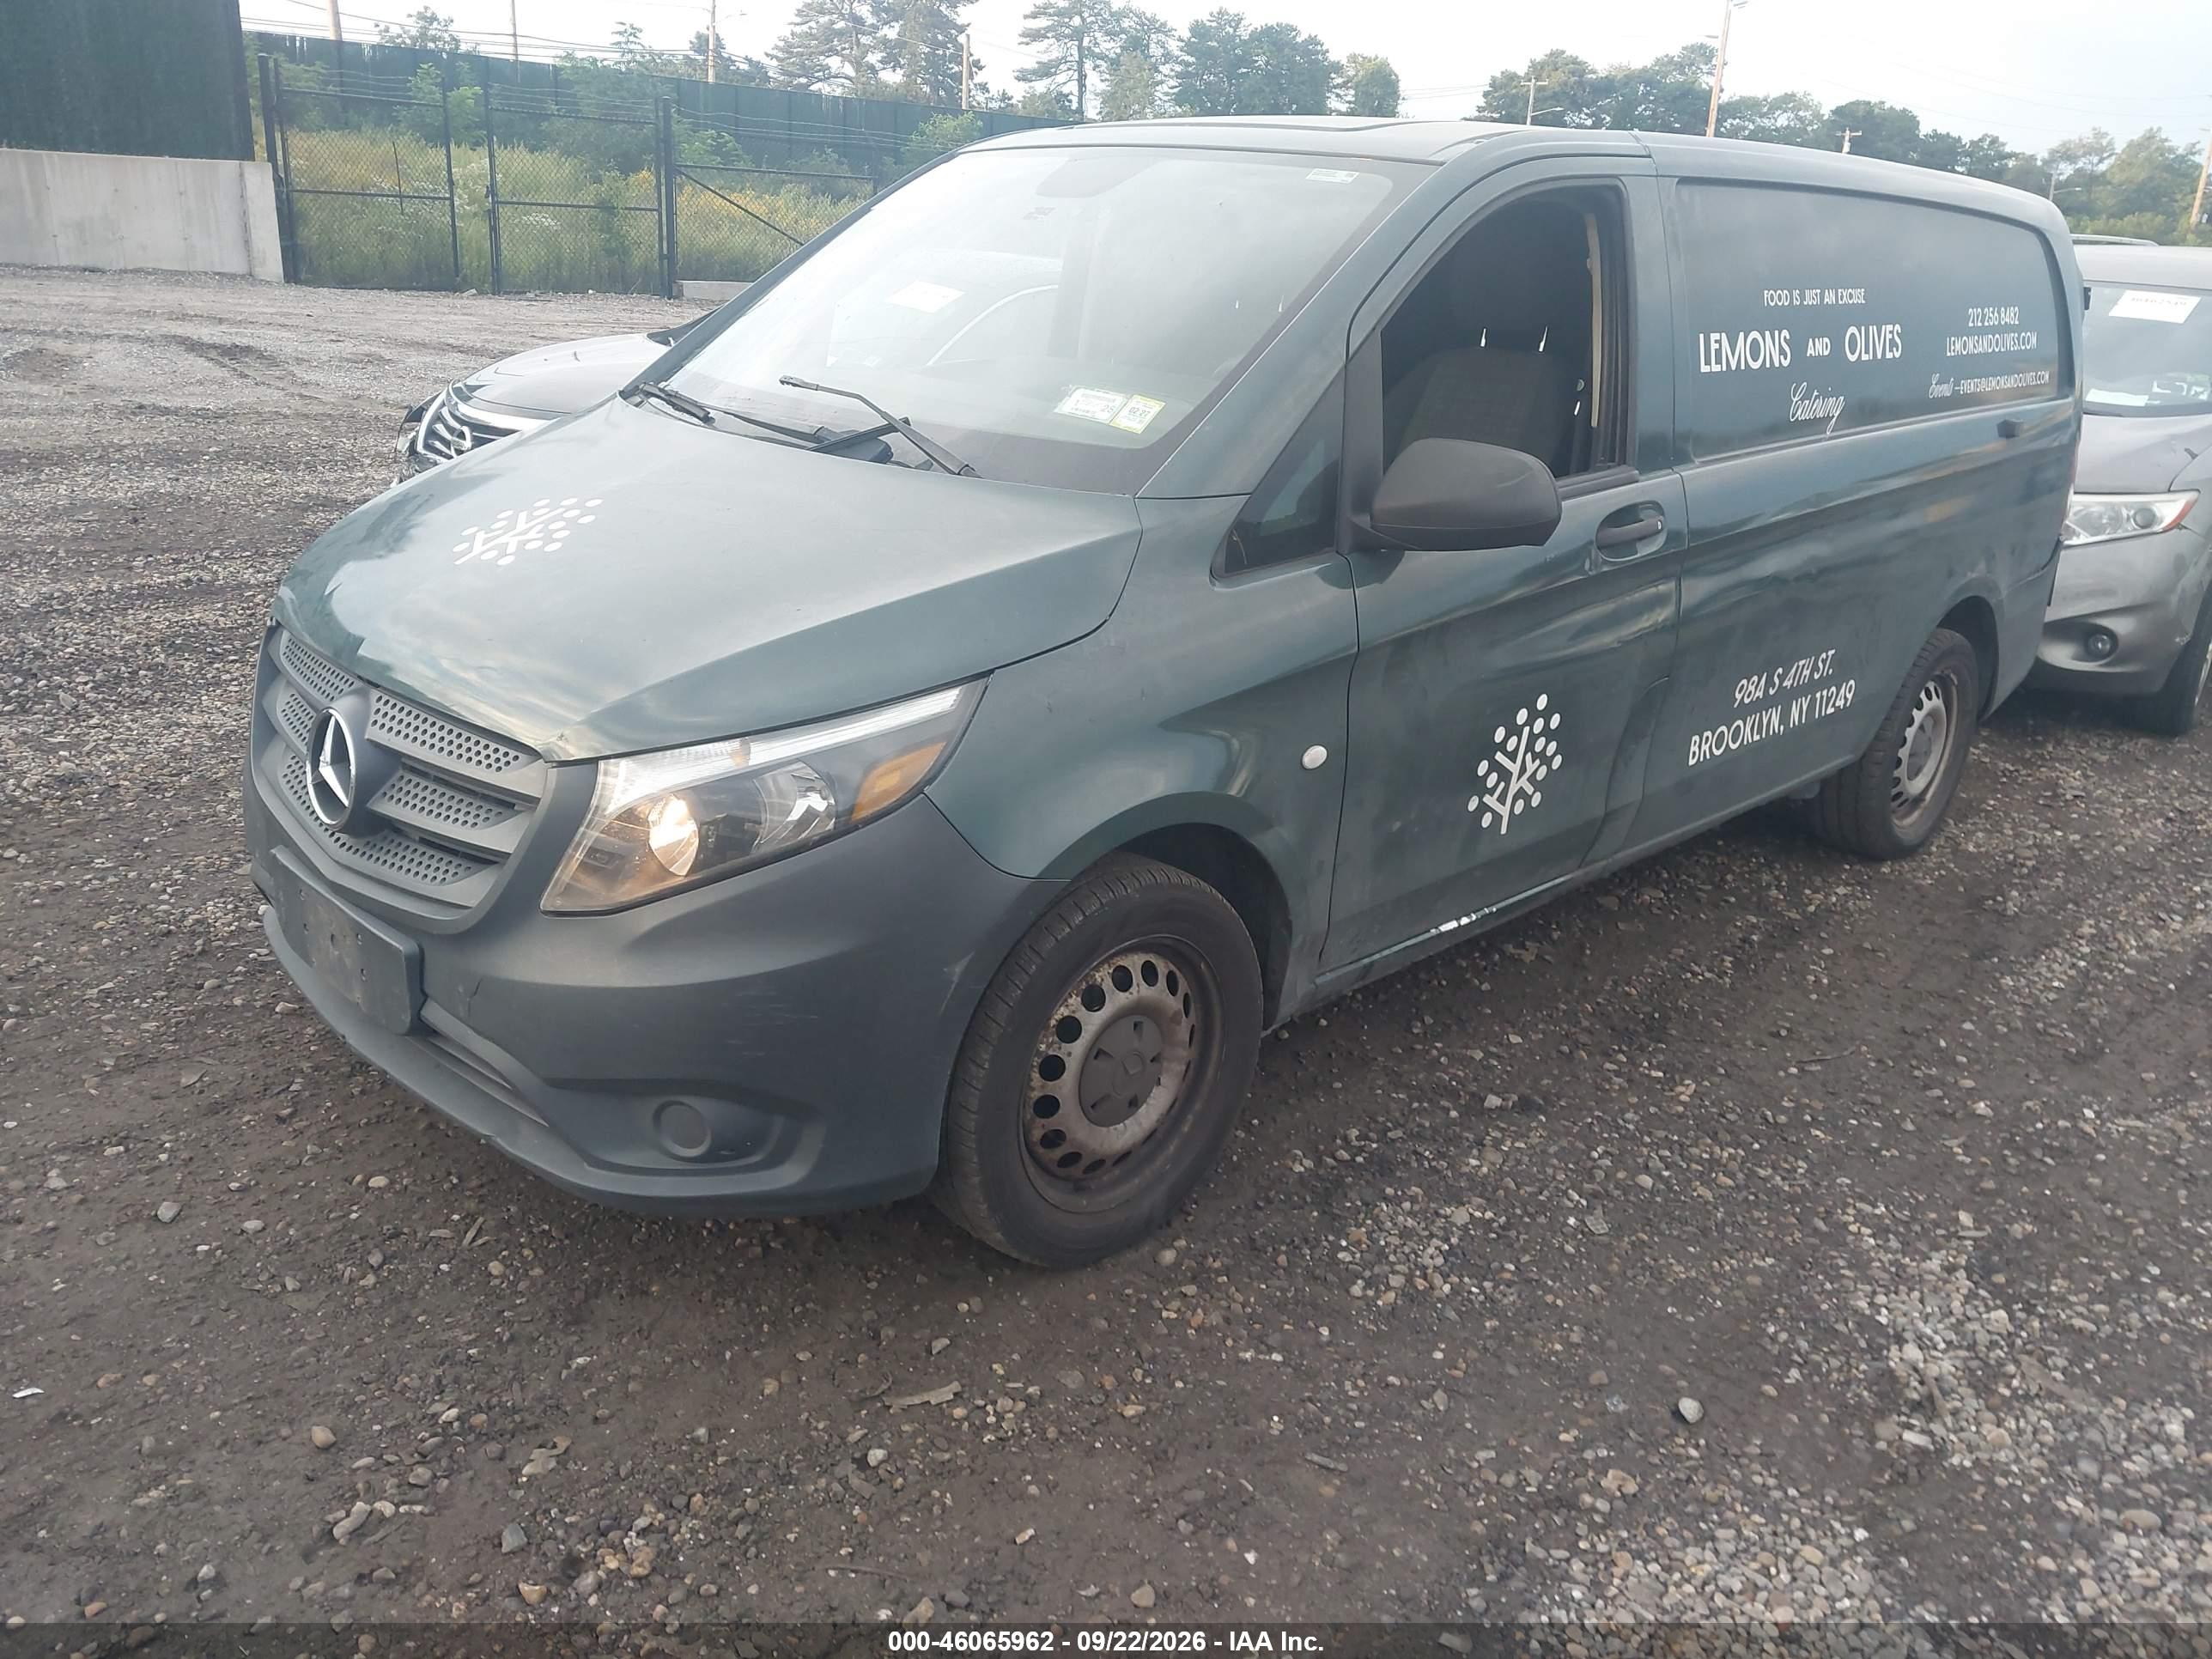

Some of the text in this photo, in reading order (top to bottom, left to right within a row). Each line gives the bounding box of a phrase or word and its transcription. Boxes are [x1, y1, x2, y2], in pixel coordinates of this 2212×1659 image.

[1764, 288, 1866, 307] FOOD IS JUST AN EXCUSE
[1968, 306, 2020, 327] 212 256 8482
[1698, 324, 1902, 374] LEMONS AND OLIVES
[1946, 331, 2038, 357] LEMONSANDOLIVES.COM
[1790, 381, 1846, 434] Catering
[1734, 648, 1836, 708] 98A S 4TH ST.
[1688, 679, 1855, 767] BROOKLYN, NY 11249
